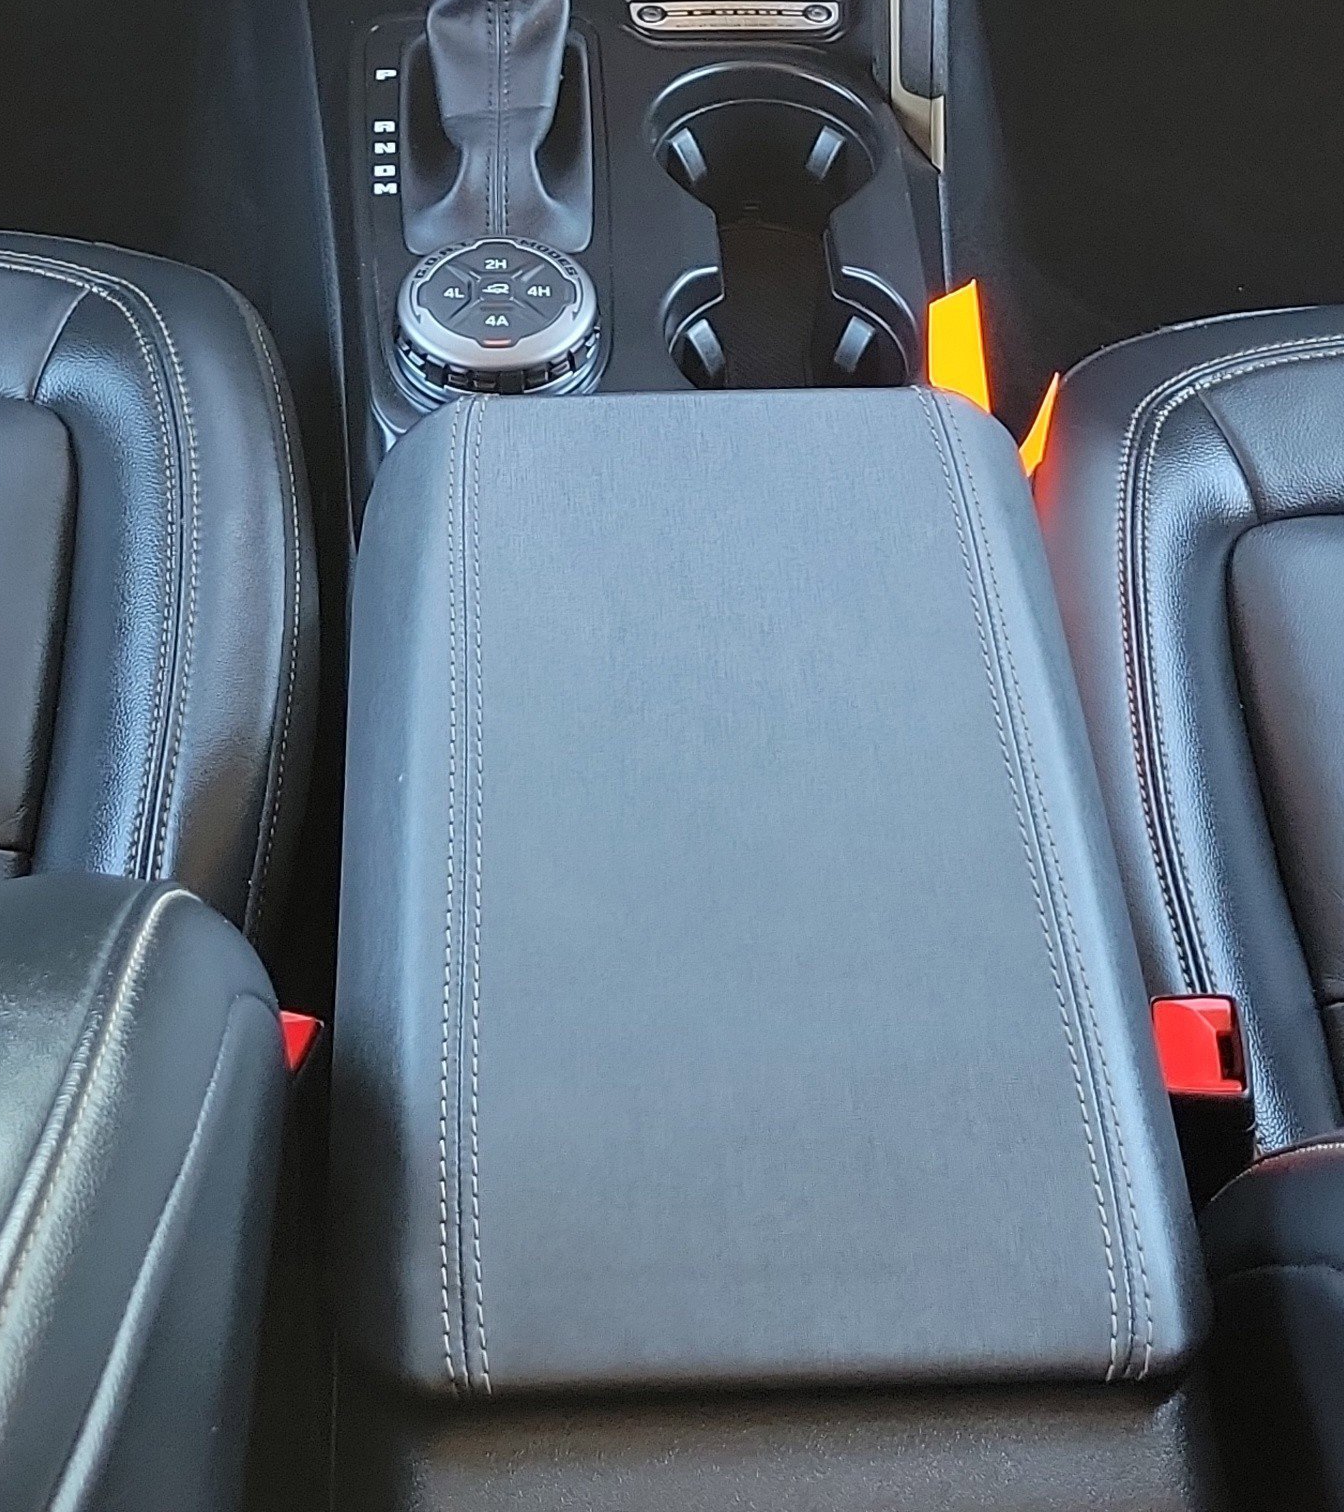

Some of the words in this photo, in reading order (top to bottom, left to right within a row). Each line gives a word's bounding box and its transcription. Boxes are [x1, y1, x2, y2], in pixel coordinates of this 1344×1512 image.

[375, 69, 397, 80] P
[374, 142, 396, 154] N
[373, 182, 397, 195] M
[485, 260, 507, 269] 2H
[443, 287, 465, 298] 4L
[527, 286, 551, 297] 4H
[485, 315, 509, 326] 4A
